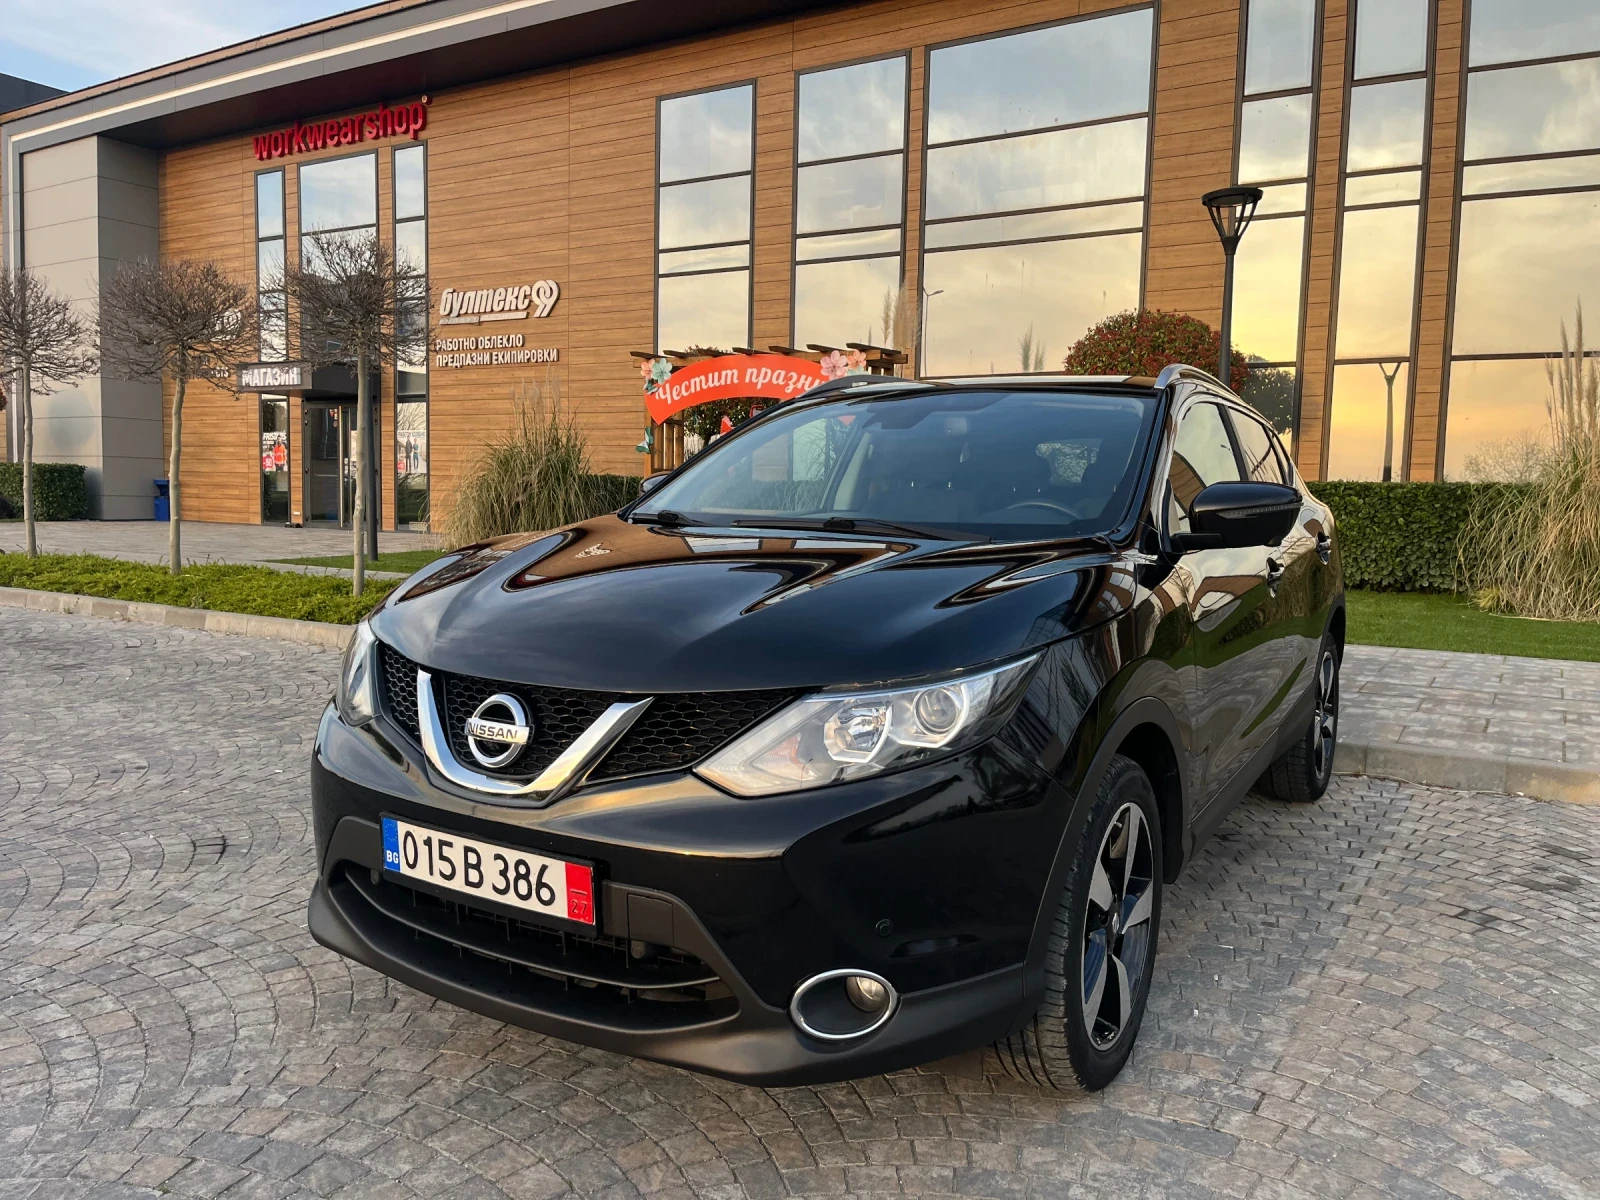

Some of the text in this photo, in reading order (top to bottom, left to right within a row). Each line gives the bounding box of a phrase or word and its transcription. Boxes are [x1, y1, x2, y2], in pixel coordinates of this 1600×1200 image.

[253, 101, 427, 160] workwearshop
[436, 334, 524, 352] РАБОТНО ОБЛЕКЛО
[436, 348, 558, 368] ПРЕДПАЗНИ ЕКИПИРОВКИ
[242, 367, 298, 387] МАГАЗИН
[655, 368, 739, 404] Честит
[468, 721, 519, 740] NISSAN
[386, 850, 399, 864] BG
